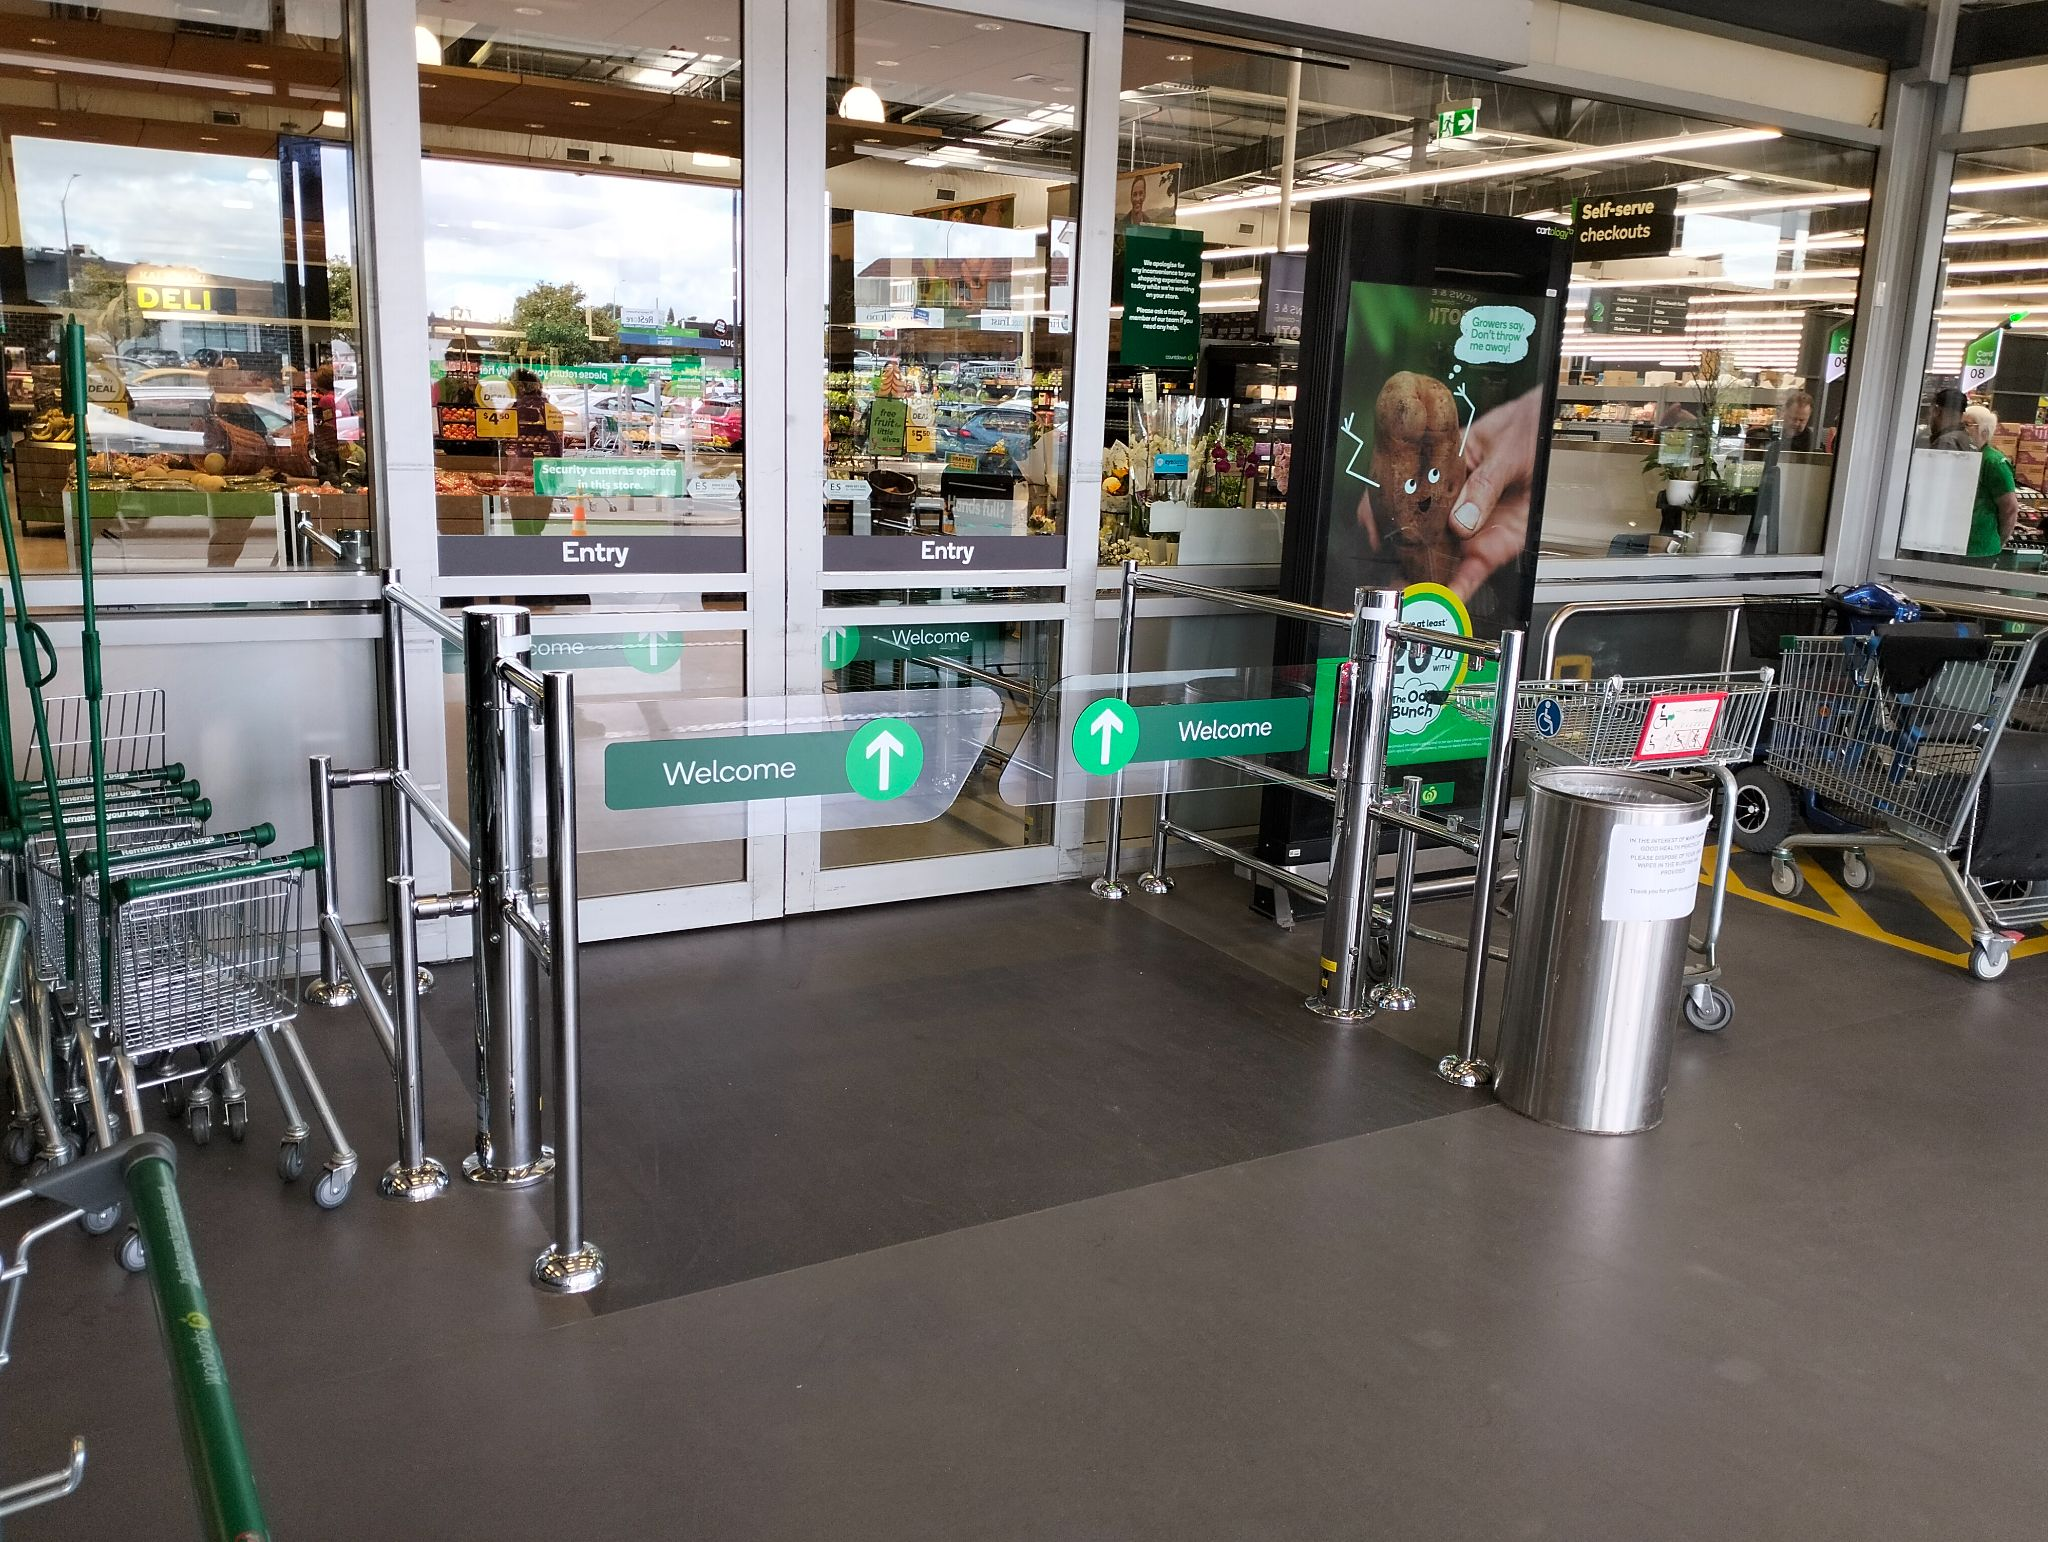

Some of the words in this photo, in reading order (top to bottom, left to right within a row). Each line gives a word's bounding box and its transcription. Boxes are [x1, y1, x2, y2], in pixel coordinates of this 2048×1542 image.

[1582, 201, 1655, 220] Self-serve
[1536, 226, 1569, 240] cartology
[1580, 223, 1651, 243] checkouts
[1131, 267, 1141, 275] any
[1138, 274, 1161, 284] shopping
[1162, 277, 1189, 285] experience
[1131, 282, 1146, 290] today
[1175, 286, 1195, 294] working
[137, 286, 211, 311] DELI
[1129, 314, 1151, 322] member
[1136, 306, 1153, 314] Please
[1168, 308, 1187, 318] friendly
[1592, 302, 1605, 322] 2
[1472, 316, 1507, 328] Growers
[1508, 321, 1525, 332] say,
[1471, 329, 1495, 339] Don't
[1497, 329, 1521, 341] throw
[1470, 343, 1483, 351] me
[1485, 343, 1511, 356] away!
[1970, 368, 1985, 379] 08
[88, 384, 116, 393] DEAL
[880, 408, 896, 418] free
[874, 417, 894, 427] fruit
[876, 427, 893, 436] little
[542, 464, 587, 476] Security
[589, 466, 634, 476] cameras
[636, 466, 677, 478] operate
[577, 479, 588, 489] in
[590, 479, 611, 490] this
[613, 480, 644, 490] store.
[948, 494, 980, 515] Hands
[982, 499, 1006, 520] full?
[562, 541, 629, 568] Entry
[921, 540, 974, 565] Entry
[891, 629, 970, 646] Welcome
[530, 642, 584, 656] come
[1432, 664, 1450, 672] WITH
[1391, 703, 1433, 719] Bunch
[1178, 719, 1273, 742] Welcome
[108, 772, 129, 780] bags
[662, 759, 797, 786] Welcome
[120, 789, 141, 797] bags
[127, 808, 150, 818] bags
[121, 843, 171, 856] Remember
[171, 839, 191, 850] your
[192, 835, 215, 846] bags
